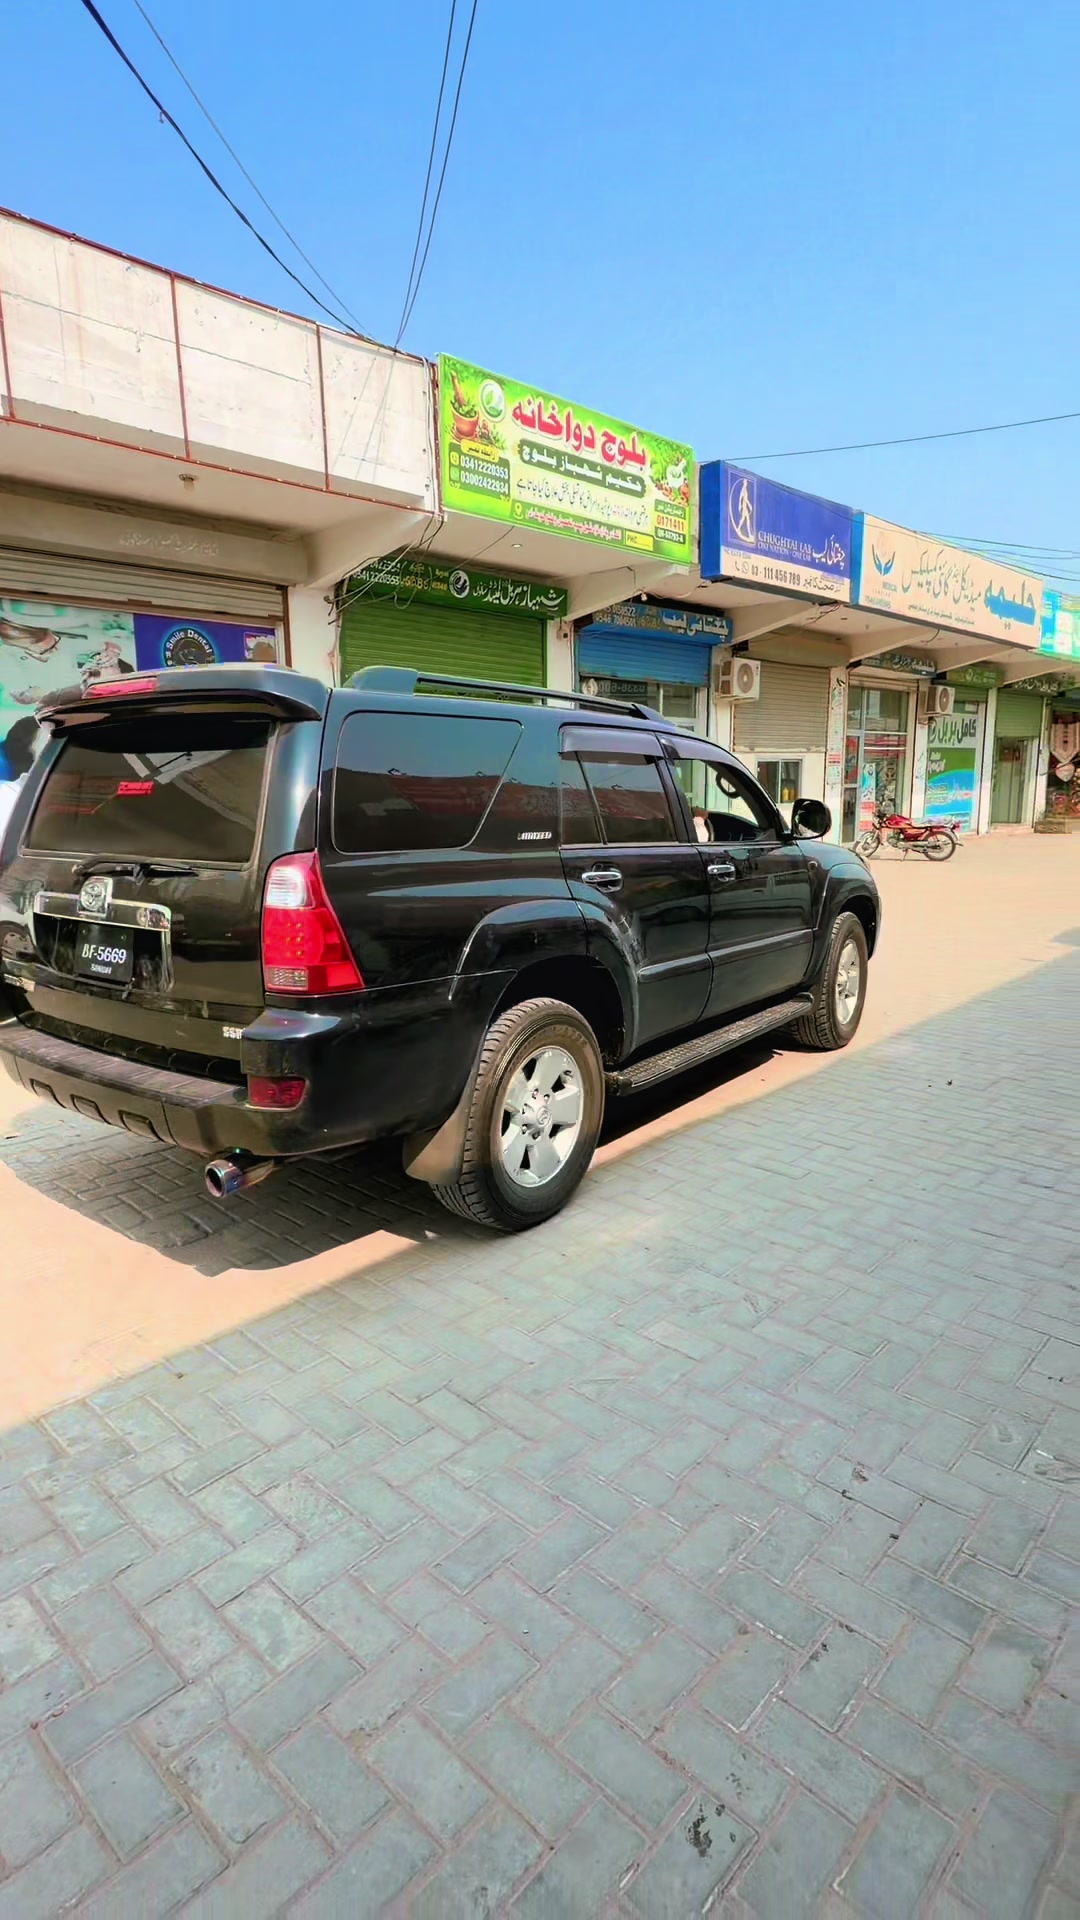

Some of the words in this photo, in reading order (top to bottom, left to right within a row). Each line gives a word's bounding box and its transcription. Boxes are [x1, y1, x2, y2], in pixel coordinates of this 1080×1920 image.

[511, 397, 596, 453] دواخانہ
[521, 444, 558, 469] بلوچ
[601, 430, 646, 472] بلوچ
[558, 454, 603, 481] شہباز
[605, 473, 643, 492] حکیم
[757, 530, 798, 551] CHUGHTAI
[984, 579, 1037, 630] حلیمہ
[662, 612, 687, 634] لیب
[166, 631, 185, 650] Smile
[187, 629, 213, 653] Dental
[82, 943, 127, 964] BF-5669
